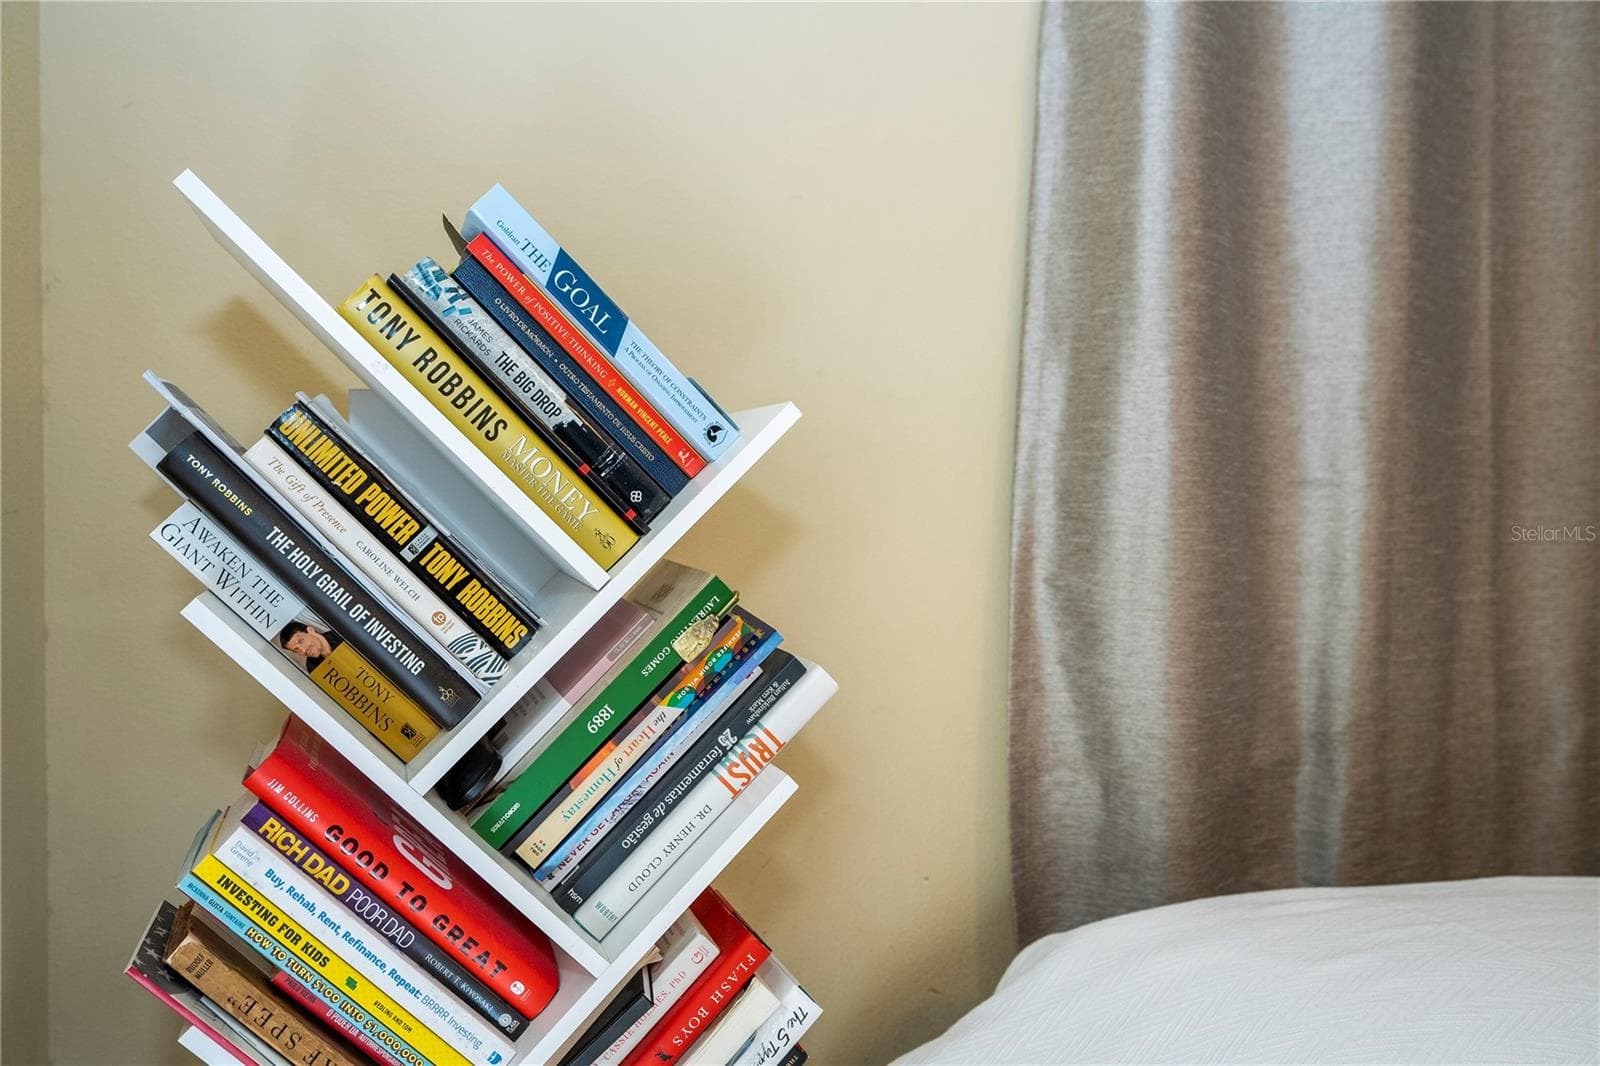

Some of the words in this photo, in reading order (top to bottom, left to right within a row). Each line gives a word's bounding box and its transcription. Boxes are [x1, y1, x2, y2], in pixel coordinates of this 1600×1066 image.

[517, 237, 553, 274] THE
[549, 264, 618, 336] GOAL
[466, 316, 493, 344] JAMES
[480, 248, 497, 265] The
[494, 262, 526, 295] POWER
[524, 292, 535, 304] of
[533, 301, 570, 339] POSITIVE
[567, 336, 609, 378] THINKING
[453, 317, 492, 357] RICKARDS
[354, 288, 421, 356] TONY
[411, 345, 509, 444] ROBBINS
[492, 350, 519, 377] THE
[512, 369, 536, 395] BIG
[529, 387, 563, 422] DROP
[494, 296, 502, 305] O
[499, 302, 519, 322] LIVRO
[516, 319, 528, 331] DE
[558, 362, 581, 385] OUTRO
[577, 381, 615, 420] TESTAMENTO
[611, 417, 623, 428] DE
[619, 425, 637, 443] JESUS
[633, 439, 655, 462] CRISTO
[629, 339, 643, 354] THE
[641, 352, 665, 376] THEORY
[662, 373, 673, 384] OF
[669, 381, 708, 421] CONSTRAINTS
[615, 386, 638, 409] NORMAN
[635, 406, 658, 429] VINCENT
[655, 427, 673, 445] PEALE
[185, 453, 214, 481] TONY
[210, 476, 254, 517] ROBBINS
[266, 455, 288, 477] The
[282, 471, 307, 496] Gift
[300, 489, 318, 507] of
[311, 498, 350, 535] Presence
[277, 408, 368, 496] UNLIMITED
[353, 480, 421, 547] POWER
[500, 448, 538, 486] MASTER
[554, 501, 583, 531] GAME
[508, 434, 599, 527] MONEY
[158, 519, 218, 577] GIANT
[213, 566, 281, 632] WITHIN
[181, 512, 254, 582] AWAKEN
[248, 572, 286, 609] THE
[354, 538, 395, 578] CAROLINE
[390, 573, 421, 603] WELCH
[264, 525, 294, 554] THE
[285, 544, 323, 582] HOLY
[314, 571, 355, 610] GRAIL
[347, 600, 371, 624] OF
[362, 615, 428, 677] INVESTING
[417, 541, 470, 594] TONY
[454, 577, 529, 650] ROBBINS
[668, 594, 720, 648] LAUREN
[639, 644, 671, 677] GOMES
[697, 656, 717, 677] ROBIN
[715, 629, 743, 659] JENNIFER
[322, 665, 396, 734] ROBBINS
[352, 666, 396, 706] TONY
[674, 675, 699, 701] WILSON
[746, 696, 764, 713] Mark
[760, 685, 774, 699] Ken
[772, 677, 792, 698] Julian
[584, 702, 616, 735] 1889
[650, 710, 668, 729] the
[744, 692, 776, 726] Birkinshaw
[621, 724, 656, 760] Heart
[715, 726, 739, 751] 25
[610, 754, 626, 771] of
[662, 744, 723, 807] ferramentas
[712, 724, 787, 800] TRUST
[266, 776, 285, 795] JIM
[281, 789, 320, 824] COLLINS
[559, 765, 616, 825] Homestay
[650, 800, 669, 820] de
[692, 803, 713, 824] DR.
[233, 838, 256, 859] David
[618, 811, 656, 851] gestão
[660, 820, 696, 858] HENRY
[229, 844, 254, 867] Greene
[626, 855, 663, 894] CLOUD
[257, 814, 310, 863] RICH
[301, 850, 352, 898] DAD
[344, 886, 389, 928] POOR
[378, 914, 417, 951] DAD
[322, 820, 392, 884] GOOD
[393, 880, 430, 916] TO
[429, 910, 509, 982] GREAT
[567, 887, 584, 905] hsm
[216, 873, 279, 928] INVESTING
[276, 921, 303, 947] FOR
[300, 940, 331, 969] KIDS
[261, 867, 288, 892] Buy,
[283, 884, 319, 918] Rehab,
[314, 909, 344, 937] Rent,
[339, 929, 390, 975] Refinance,
[385, 966, 424, 1002] Repeat:
[419, 993, 450, 1022] BRRRR
[444, 1015, 484, 1051] Investing
[668, 969, 687, 989] PhD
[708, 952, 757, 1004] FLASH
[244, 925, 272, 951] HOW
[270, 945, 287, 962] TO
[284, 956, 314, 983] TURN
[311, 978, 341, 1005] $100
[338, 999, 365, 1024] INTO
[361, 1018, 425, 1066] $1,000,000
[423, 952, 454, 979] ROBERT
[451, 974, 463, 986] T.
[458, 981, 494, 1013] KIYOSAKI
[330, 1011, 352, 1031] PODER
[390, 1014, 403, 1026] AND
[670, 1005, 709, 1048] BOYS
[772, 1026, 793, 1047] 5
[782, 1004, 810, 1033] The
